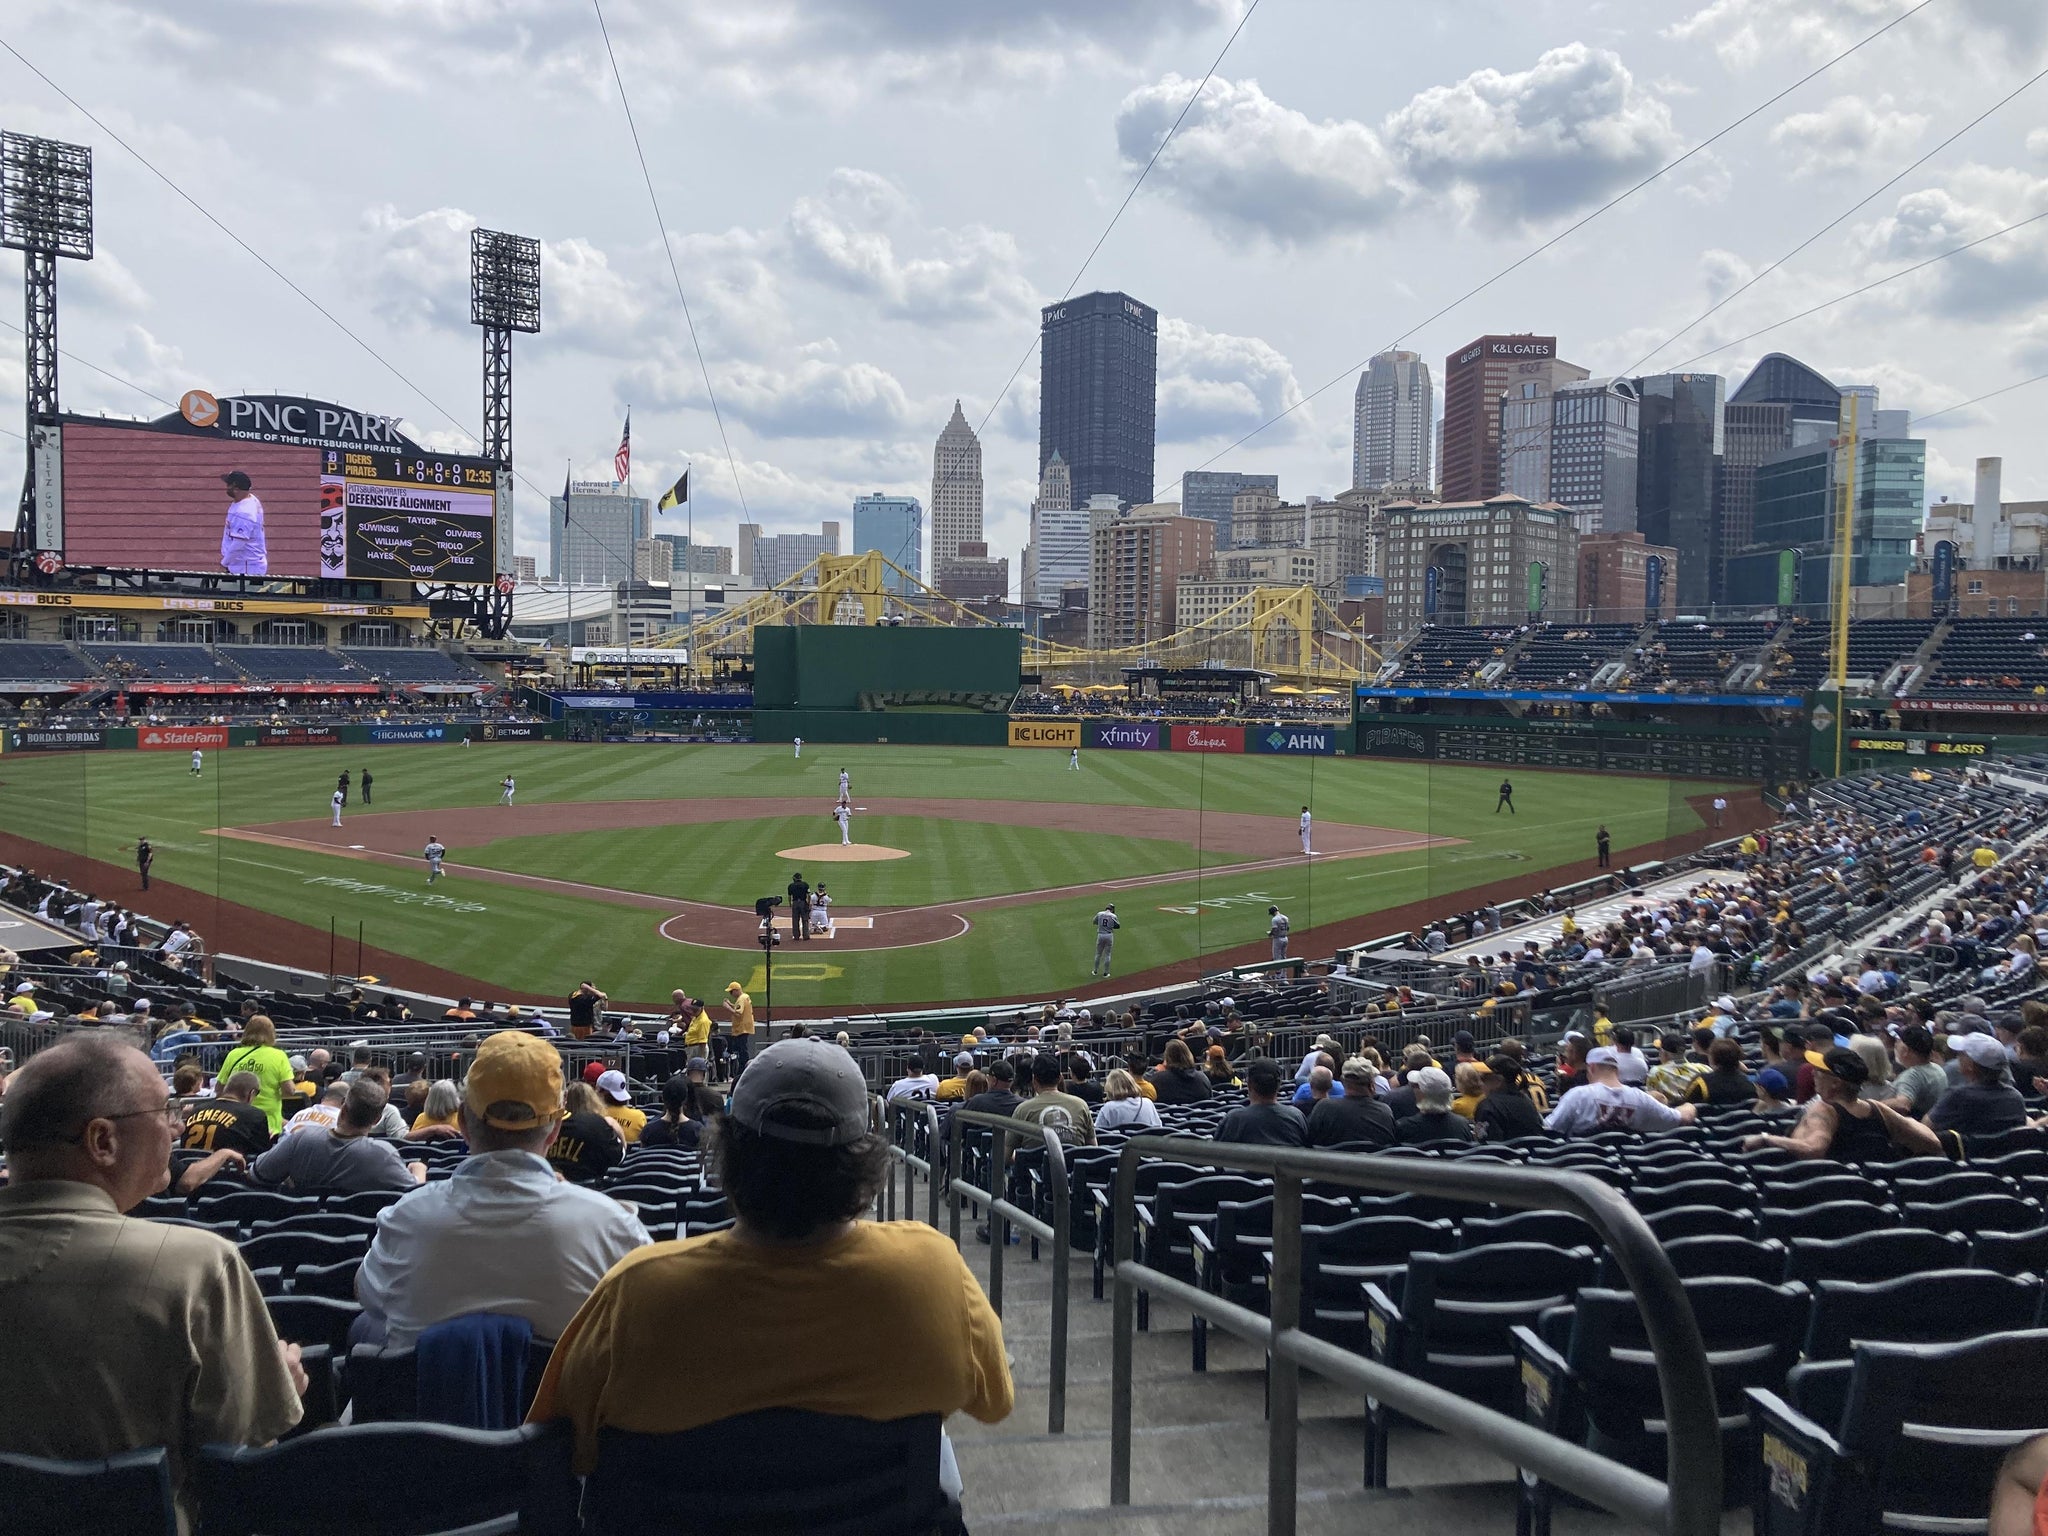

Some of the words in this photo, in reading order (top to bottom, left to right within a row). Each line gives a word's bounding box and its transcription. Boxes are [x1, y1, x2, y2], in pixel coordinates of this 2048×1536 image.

[1124, 301, 1143, 318] UPMC
[1041, 308, 1066, 324] UPMC
[1469, 346, 1481, 362] GATES
[1492, 344, 1513, 354] K&L
[1514, 344, 1549, 355] GATES
[1691, 374, 1708, 382] PNC
[226, 399, 305, 434] PNC
[315, 409, 404, 444] PARK
[231, 430, 261, 441] HOME
[263, 433, 278, 443] OF
[280, 434, 300, 445] THE
[302, 437, 361, 451] PITTSBURGH
[364, 443, 402, 454] PIRATES
[345, 453, 372, 465] TIGERS
[345, 465, 377, 477] PIRATES
[407, 465, 414, 474] R
[426, 467, 434, 476] H
[444, 469, 450, 478] E
[416, 460, 425, 471] 0
[435, 462, 443, 472] 0
[452, 463, 461, 474] 0
[416, 471, 425, 482] 0
[435, 473, 443, 483] 0
[452, 474, 461, 485] 0
[465, 469, 492, 483] 12:35
[348, 484, 383, 494] PITTSBURGH
[383, 488, 407, 497] PIRATES
[45, 493, 53, 509] GO
[349, 493, 398, 507] DEFENSIVE
[400, 497, 452, 511] ALIGNMENT
[407, 516, 437, 525] TAYLOR
[358, 523, 399, 533] SUWINSKI
[445, 529, 482, 539] OLIVARES
[374, 537, 412, 547] WILLIAMS
[436, 541, 463, 550] TRIOLO
[367, 551, 394, 560] HAYES
[450, 556, 474, 565] TELLEZ
[410, 564, 434, 573] DAVIS
[37, 594, 72, 605] BUCS
[214, 601, 244, 611] BUCS
[367, 606, 394, 616] BUCS
[1932, 701, 1951, 710] Most
[1952, 702, 1990, 711] delicious
[1992, 703, 2014, 712] seats
[308, 727, 329, 735] Ever?
[376, 729, 424, 739] HIGHMARK
[498, 728, 531, 737] BETMGM
[1014, 727, 1031, 741] IC
[1033, 728, 1075, 742] LIGHT
[1101, 726, 1151, 746] xfinity
[27, 733, 62, 743] BORDAS
[65, 732, 100, 742] BORDAS
[1288, 733, 1325, 750] AHN
[1366, 727, 1424, 753] PIRATES
[1858, 740, 1905, 751] BOWSER
[1938, 744, 1984, 755] BLASTS
[608, 1059, 616, 1067] 17
[186, 1109, 237, 1129] CLEMENTE
[185, 1124, 217, 1150] 21
